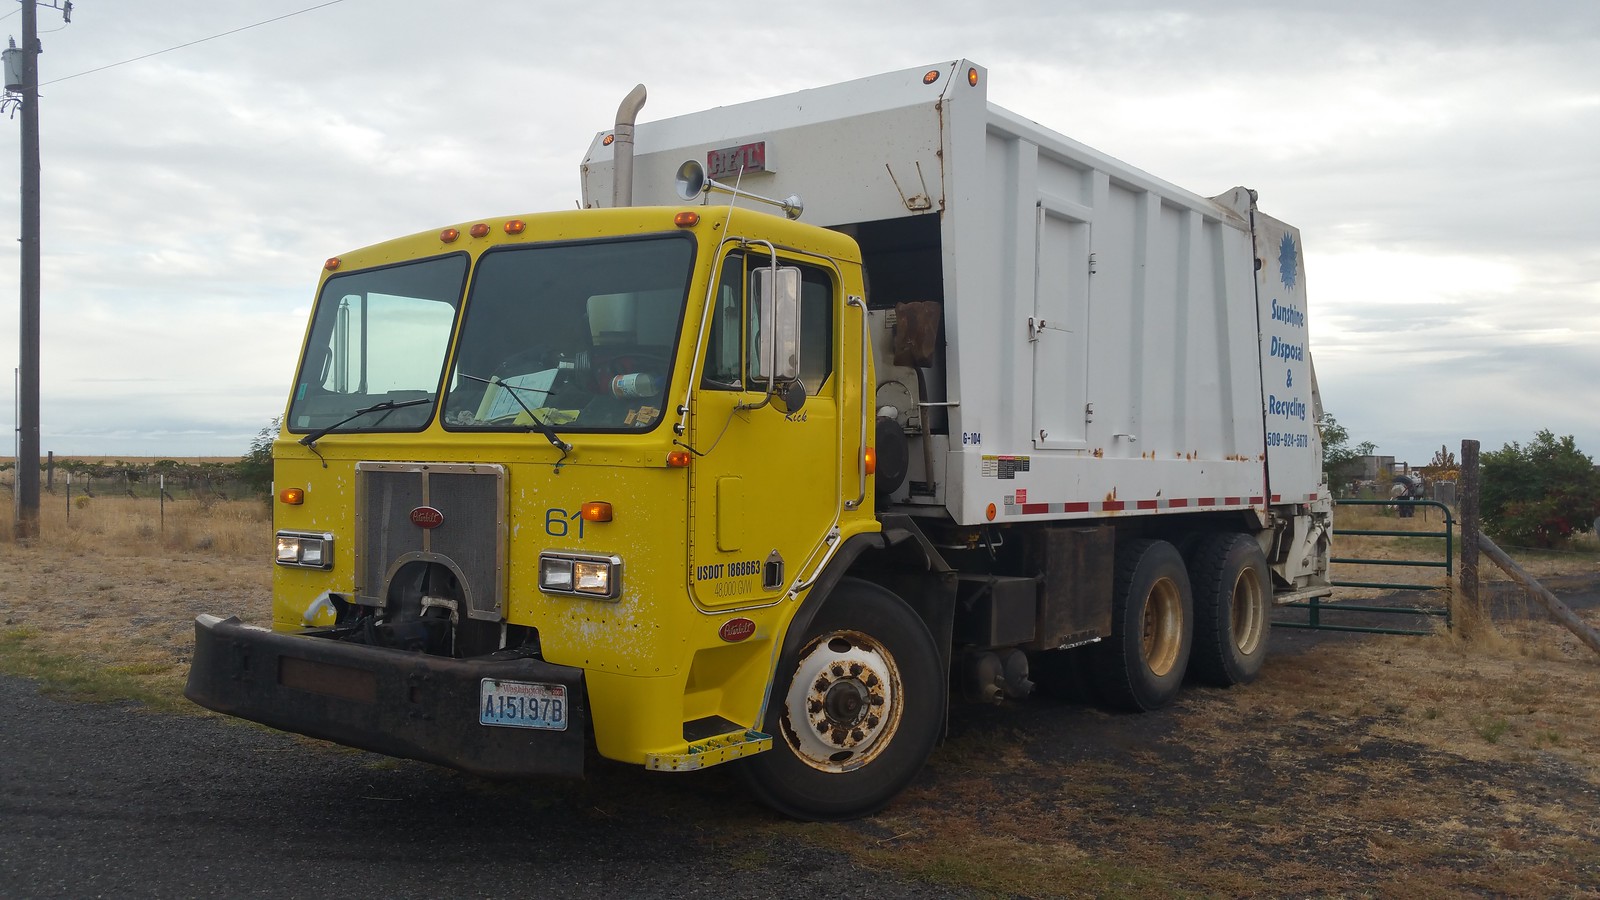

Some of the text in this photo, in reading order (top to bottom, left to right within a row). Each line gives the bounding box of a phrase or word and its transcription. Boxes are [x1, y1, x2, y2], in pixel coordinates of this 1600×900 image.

[712, 148, 760, 174] HEIL
[1271, 298, 1304, 328] Sunshine
[1270, 335, 1304, 363] Disposal
[1286, 368, 1293, 389] &
[1269, 394, 1306, 422] Recycling
[1267, 432, 1308, 448] 509-924-5678
[545, 507, 584, 539] 61
[697, 560, 761, 581] USDOT 1868663
[738, 579, 753, 595] GVW
[724, 622, 753, 638] Peterbilt
[502, 684, 545, 697] Washington
[485, 694, 562, 722] A15197B
